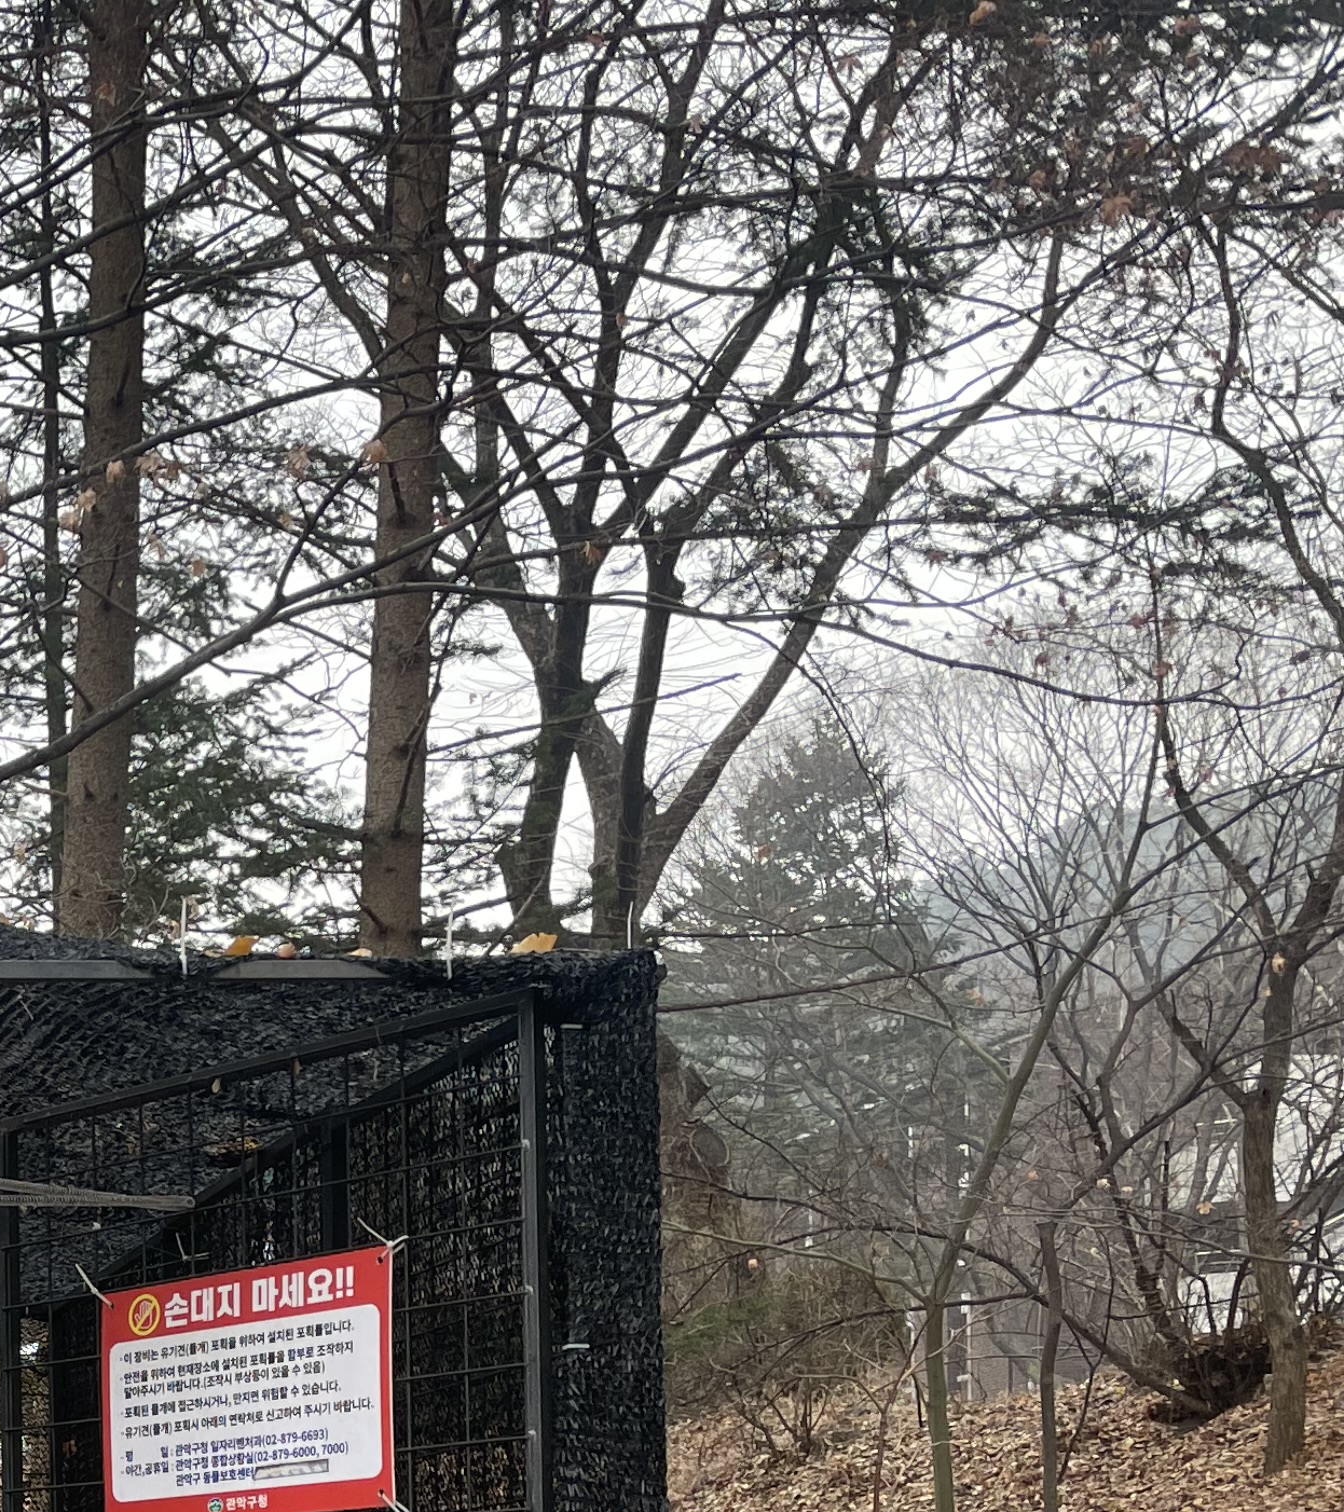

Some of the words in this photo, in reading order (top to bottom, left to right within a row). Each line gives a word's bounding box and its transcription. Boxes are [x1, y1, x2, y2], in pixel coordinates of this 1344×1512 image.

[164, 1281, 241, 1329] 손대지
[252, 1266, 355, 1312] 마세요!!
[124, 1353, 132, 1364] 이
[134, 1349, 159, 1363] 장비는
[161, 1341, 209, 1357] 유기견(들개)
[211, 1337, 236, 1351] 포획을
[239, 1332, 265, 1348] 위하여
[268, 1329, 293, 1343] 설치된
[297, 1319, 354, 1338] 포획틀입니다.
[124, 1370, 148, 1385] 안전을
[151, 1367, 175, 1380] 위하여
[178, 1360, 220, 1376] 현재장소에
[222, 1356, 248, 1369] 설치된
[250, 1351, 285, 1366] 포획틀을
[288, 1346, 314, 1361] 함부로
[317, 1341, 354, 1356] 조작하지
[124, 1382, 164, 1399] 말아주시기
[235, 1368, 269, 1384] 부상등이
[272, 1365, 289, 1379] 있을
[292, 1365, 301, 1376] 수
[303, 1361, 325, 1374] 있음)
[124, 1404, 149, 1418] 포획된
[152, 1401, 176, 1416] 들개에
[178, 1395, 231, 1411] 접근하시거나,
[233, 1390, 259, 1405] 만지면
[262, 1387, 288, 1401] 위험할
[291, 1386, 299, 1397] 수
[302, 1380, 342, 1396] 있습니다.
[125, 1422, 172, 1439] 유기견(들개)
[174, 1418, 200, 1432] 포획시
[201, 1415, 227, 1428] 아래의
[229, 1411, 264, 1426] 연락처로
[266, 1406, 301, 1422] 신고하여
[304, 1403, 330, 1417] 주시기
[334, 1397, 374, 1413] 바랍니다.
[176, 1441, 208, 1457] 관악구청
[176, 1456, 209, 1471] 관악구청
[322, 1442, 349, 1456] 7000)
[176, 1473, 200, 1486] 관악구
[203, 1467, 254, 1484] 동물보호센터
[225, 1494, 269, 1510] 관악구청
